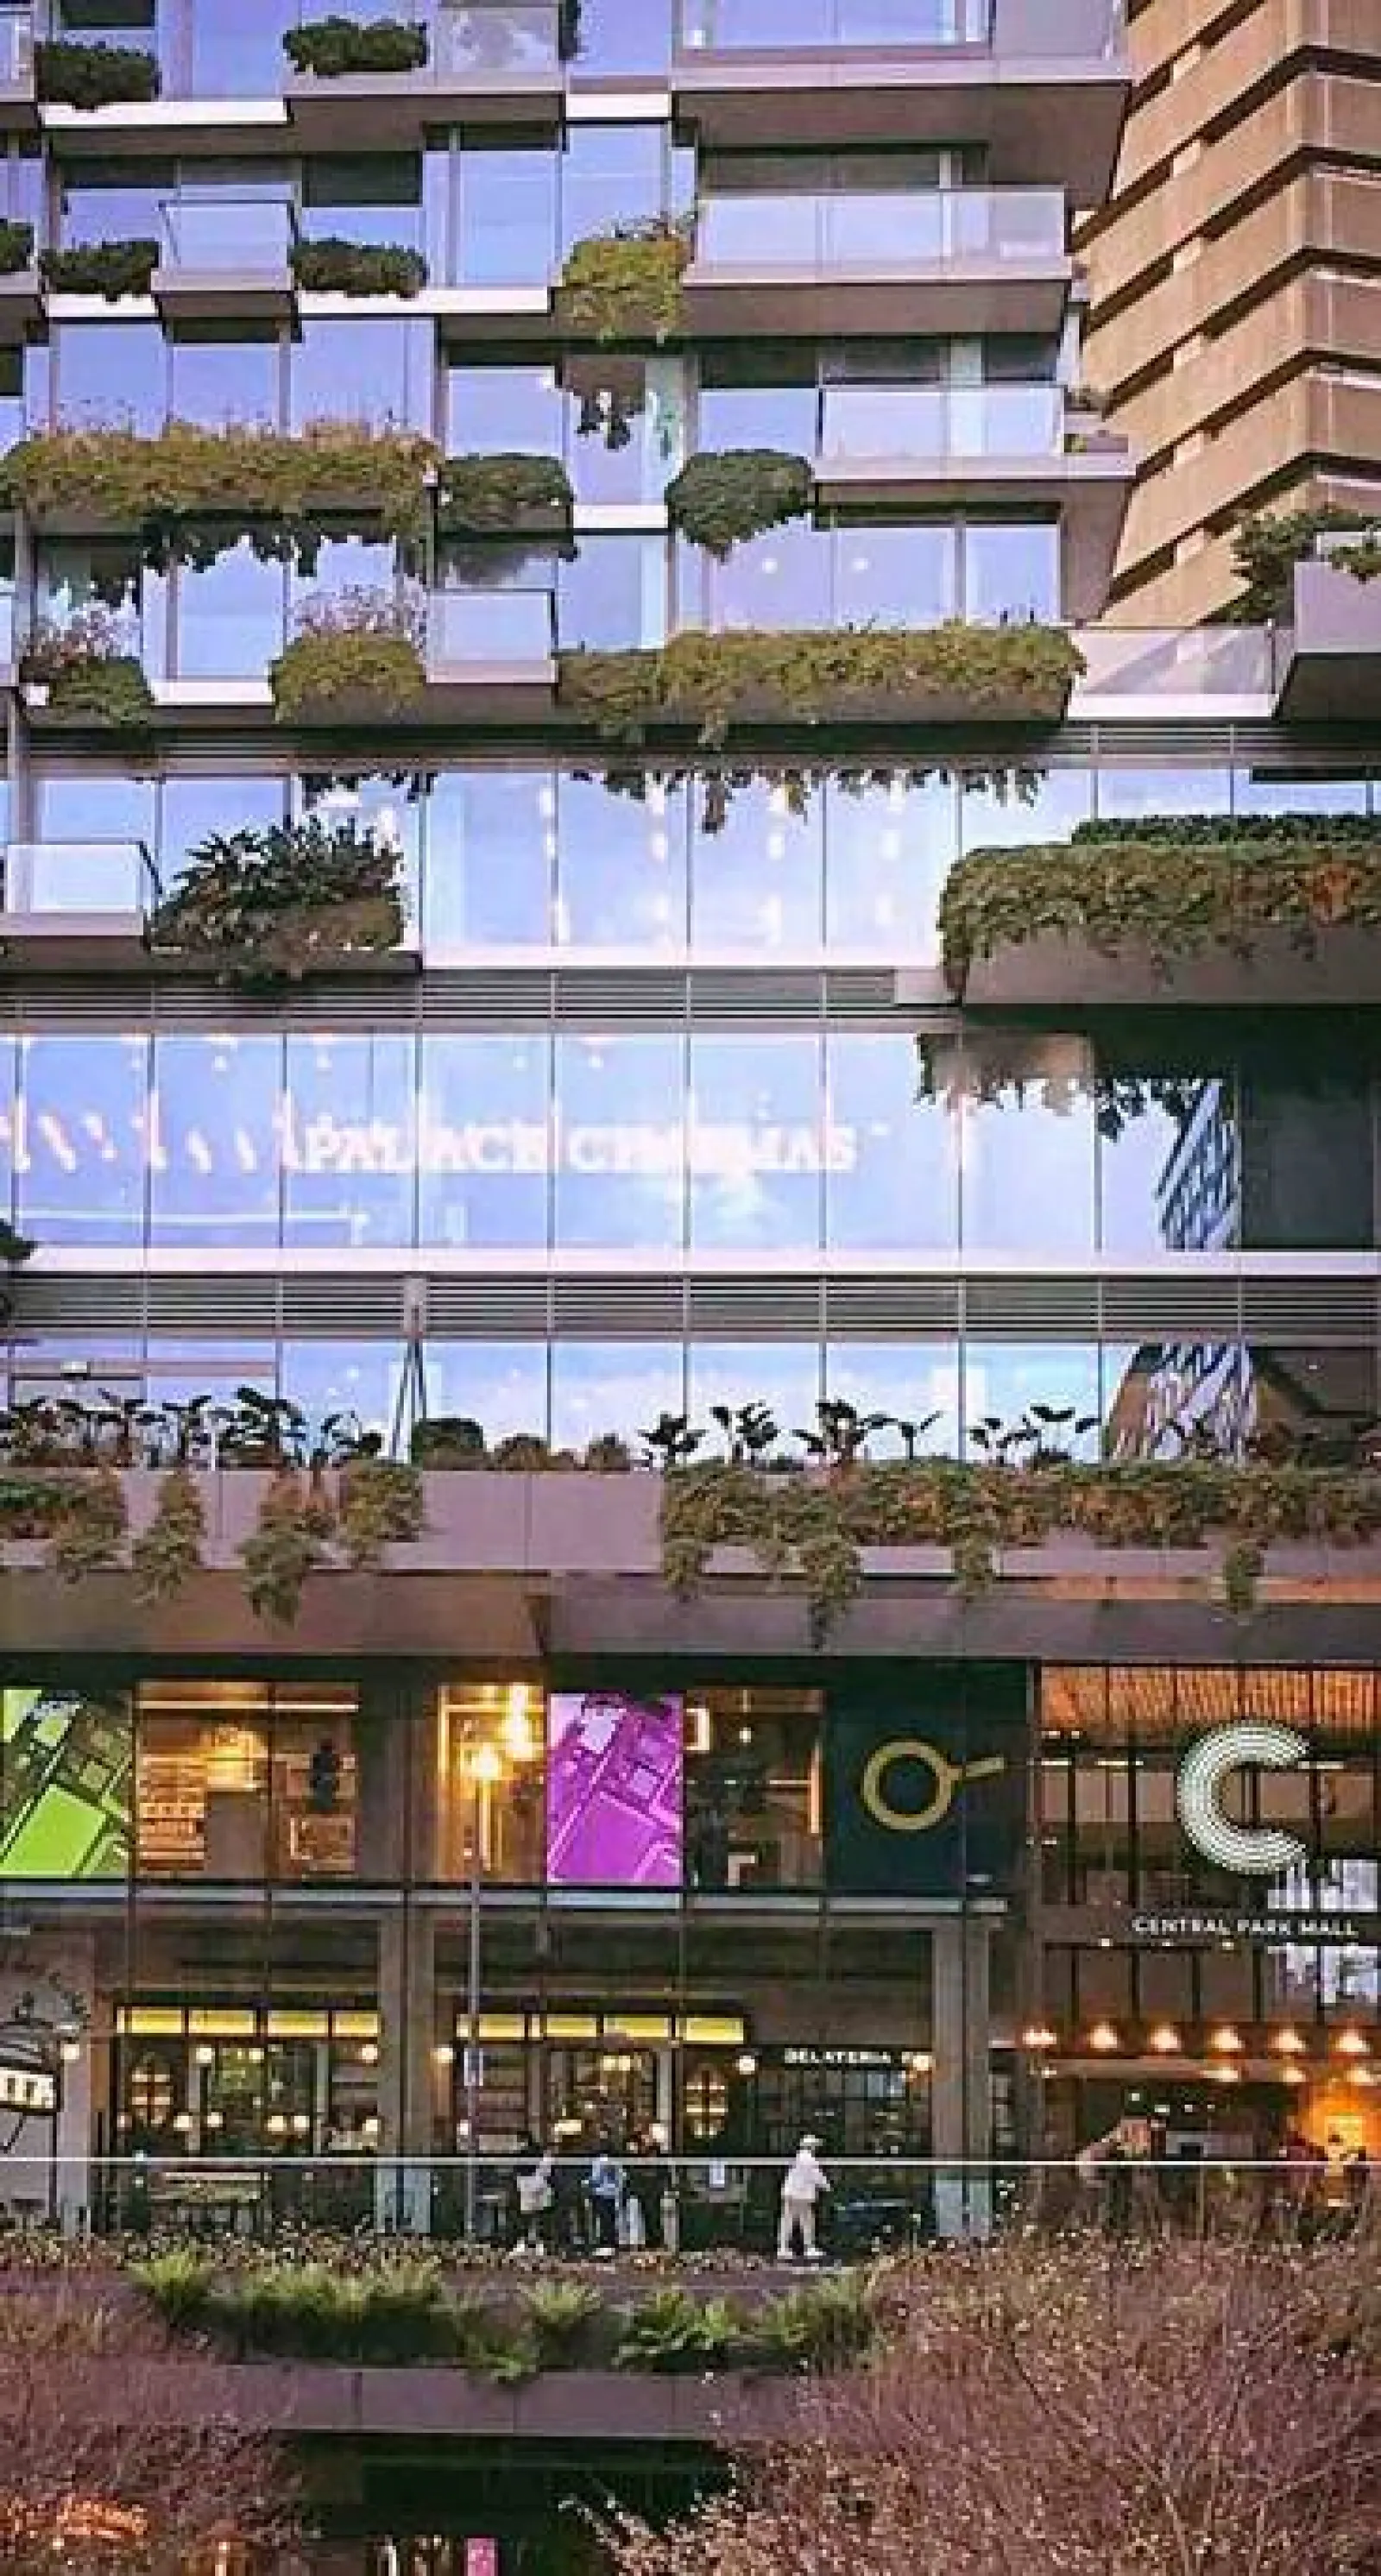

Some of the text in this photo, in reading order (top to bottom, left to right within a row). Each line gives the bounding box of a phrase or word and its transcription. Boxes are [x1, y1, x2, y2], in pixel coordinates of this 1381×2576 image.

[569, 1124, 856, 1172] CIMAS
[1132, 1914, 1359, 1936] CENTRAL PARK MALL
